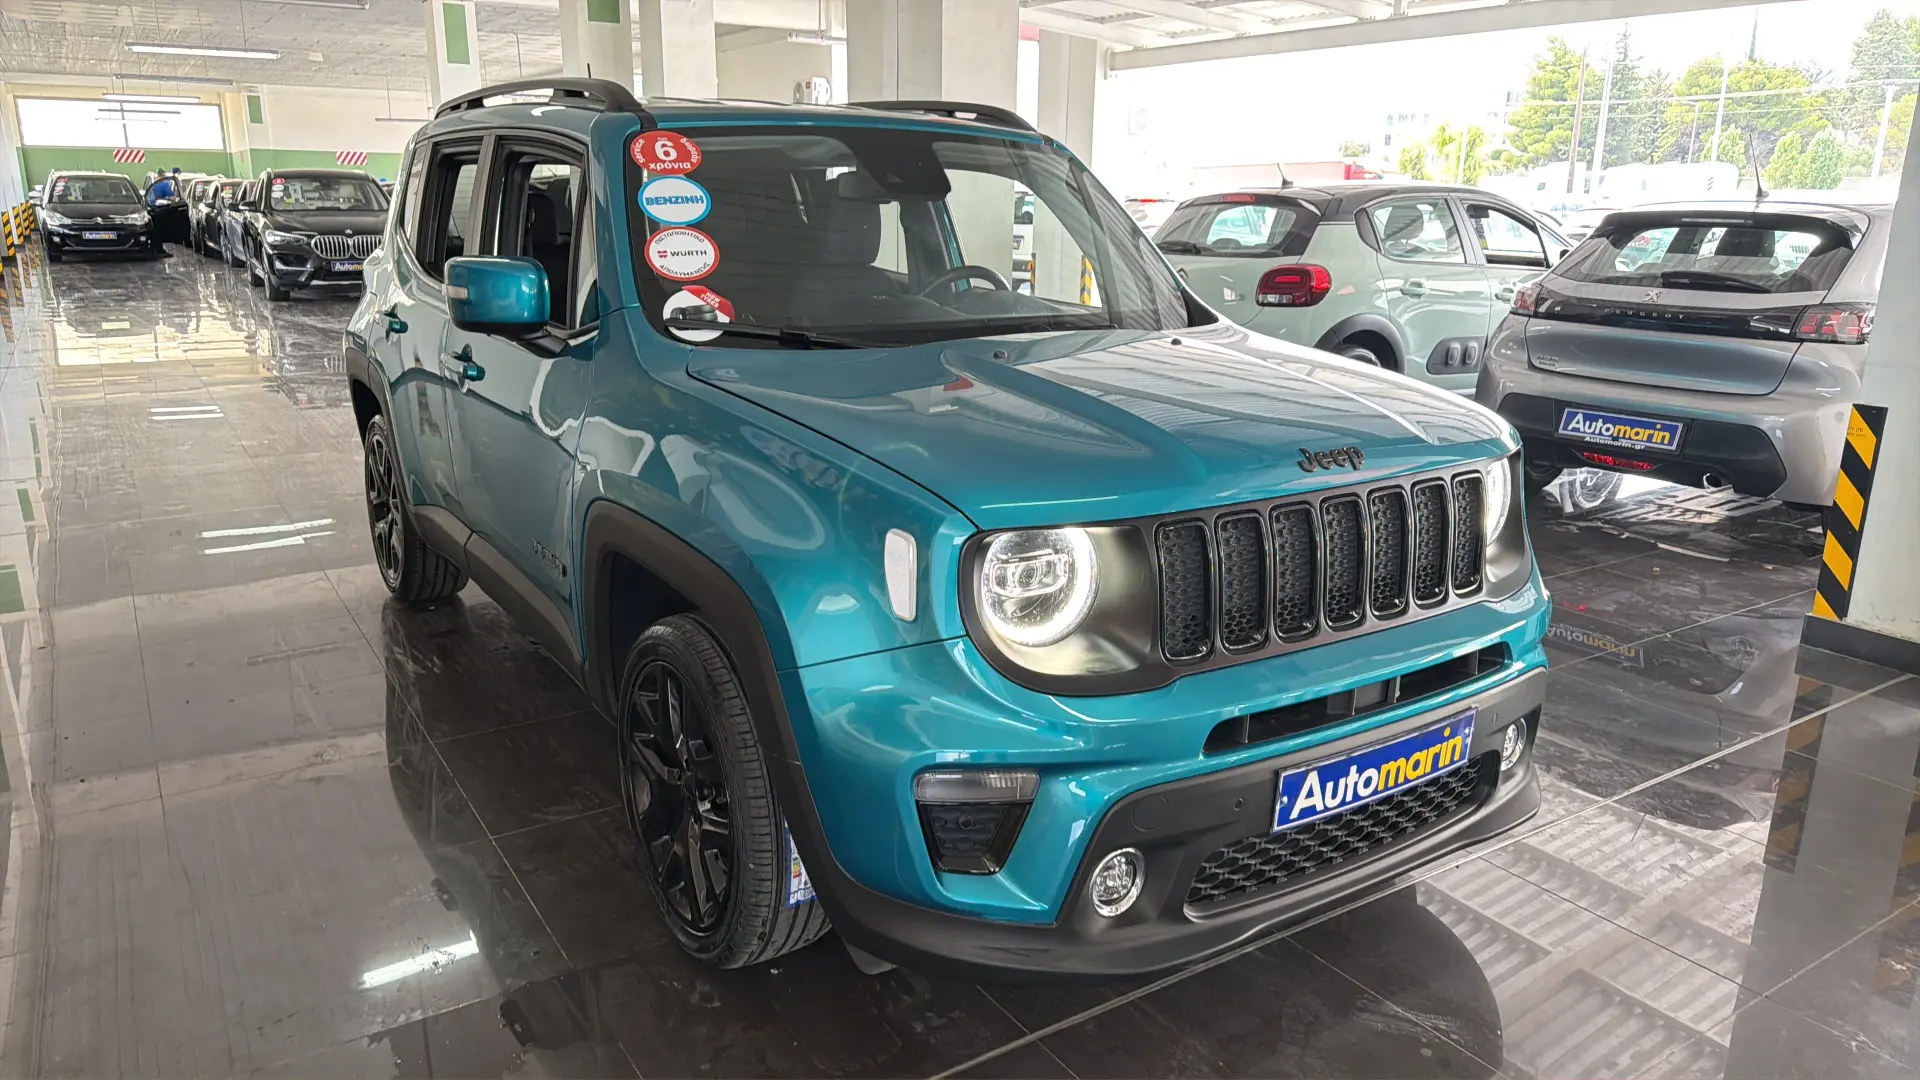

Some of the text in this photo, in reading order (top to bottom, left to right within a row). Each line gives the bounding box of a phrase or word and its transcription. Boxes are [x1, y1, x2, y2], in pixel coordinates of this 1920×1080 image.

[633, 138, 646, 164] service
[654, 140, 678, 161] 6
[648, 161, 692, 171] χρόνια
[699, 293, 720, 309] TYRES
[705, 291, 721, 303] NEW
[1604, 308, 1685, 320] PEUGEOT
[1567, 412, 1671, 444] Automarin
[1584, 436, 1646, 450] Automarin.gr
[1297, 446, 1366, 473] Jeep
[1288, 726, 1463, 820] Automarin
